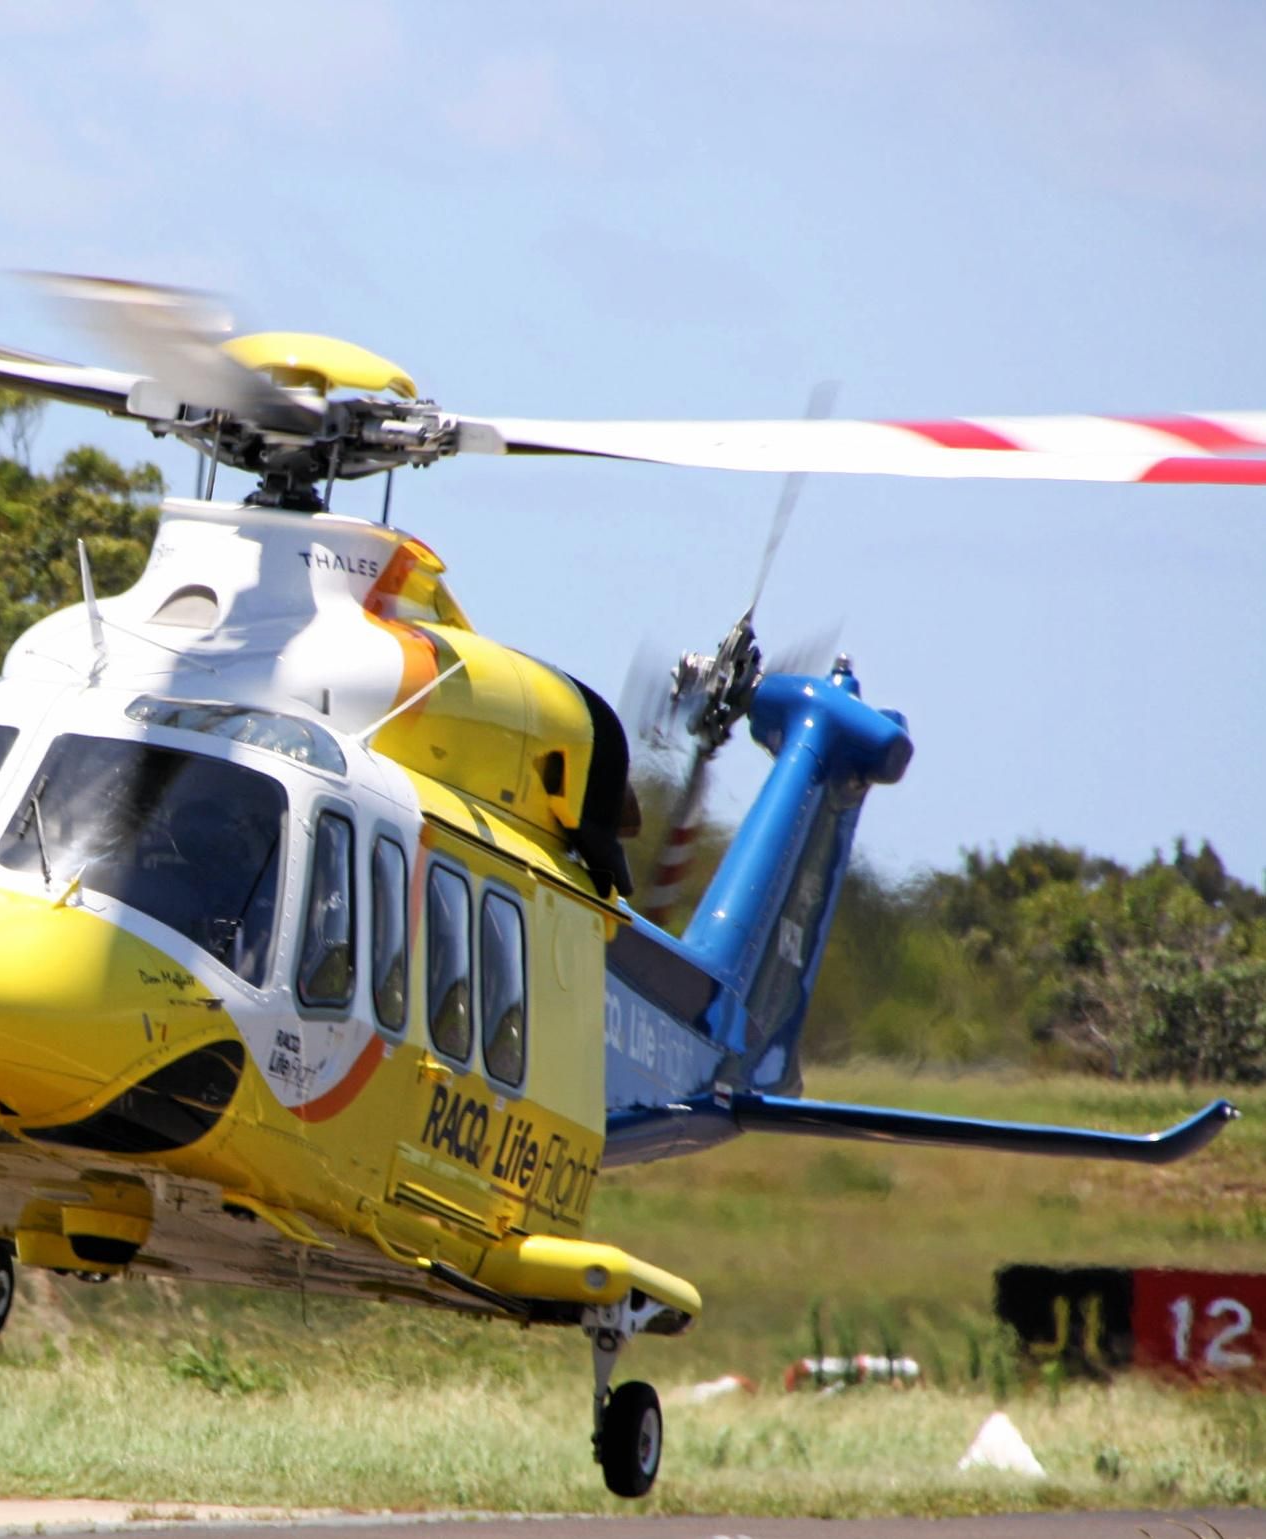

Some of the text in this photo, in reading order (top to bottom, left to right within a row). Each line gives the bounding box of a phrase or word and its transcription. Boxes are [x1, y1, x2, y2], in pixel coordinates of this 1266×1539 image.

[298, 551, 379, 578] THALES
[421, 1083, 489, 1170] RACQ
[1168, 1296, 1254, 1366] 12
